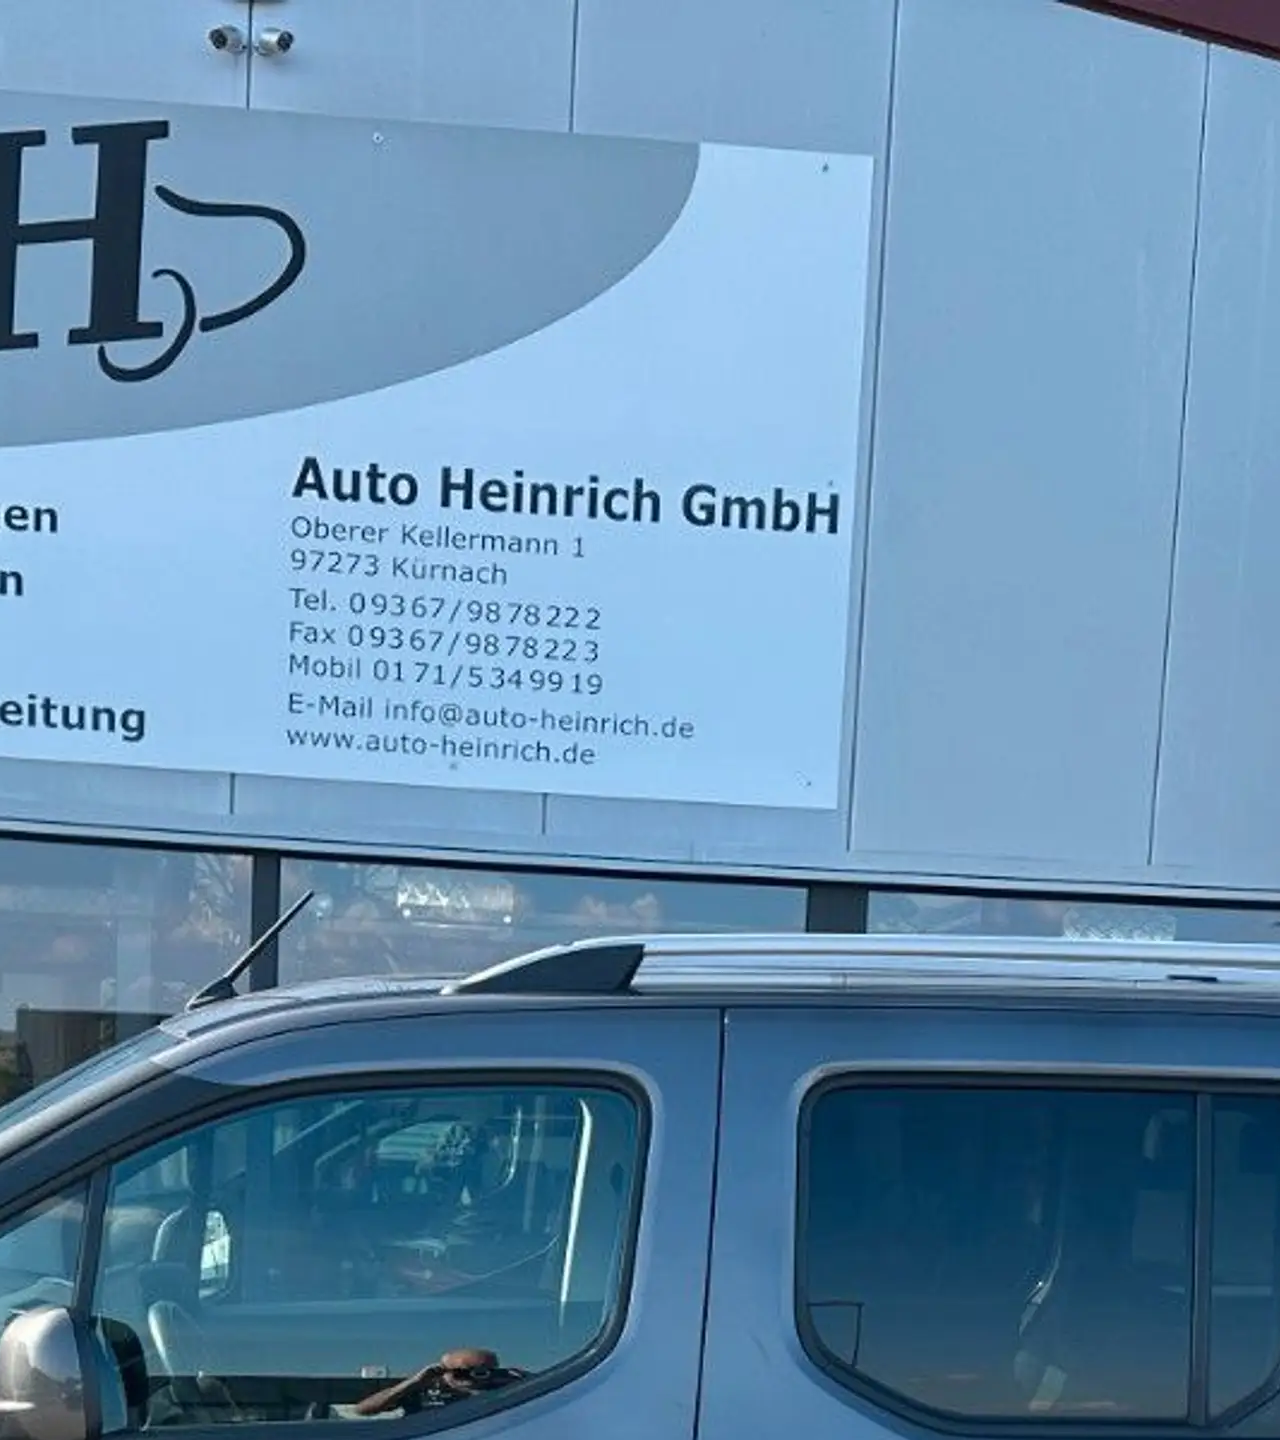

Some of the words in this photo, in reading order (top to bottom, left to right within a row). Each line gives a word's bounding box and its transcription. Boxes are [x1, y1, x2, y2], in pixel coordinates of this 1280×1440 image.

[292, 456, 418, 507] Auto
[440, 466, 661, 523] Heinrich
[682, 483, 840, 534] GmbH
[290, 515, 389, 545] Oberer
[401, 522, 558, 556] Kellermann
[571, 537, 586, 558] 1
[290, 549, 380, 577] 97273
[392, 557, 508, 586] Kürnach
[289, 588, 337, 612] Tel.
[348, 592, 601, 630] 09367/9878222
[289, 621, 337, 645] Fax
[347, 625, 600, 663] 09367/9878223
[288, 653, 361, 680] Mobil
[372, 658, 603, 695] 0171/5349919
[287, 692, 373, 718] E-Mail
[385, 697, 695, 739] info@auto-heinrich.de
[287, 728, 596, 765] www.auto-heinrich.de
